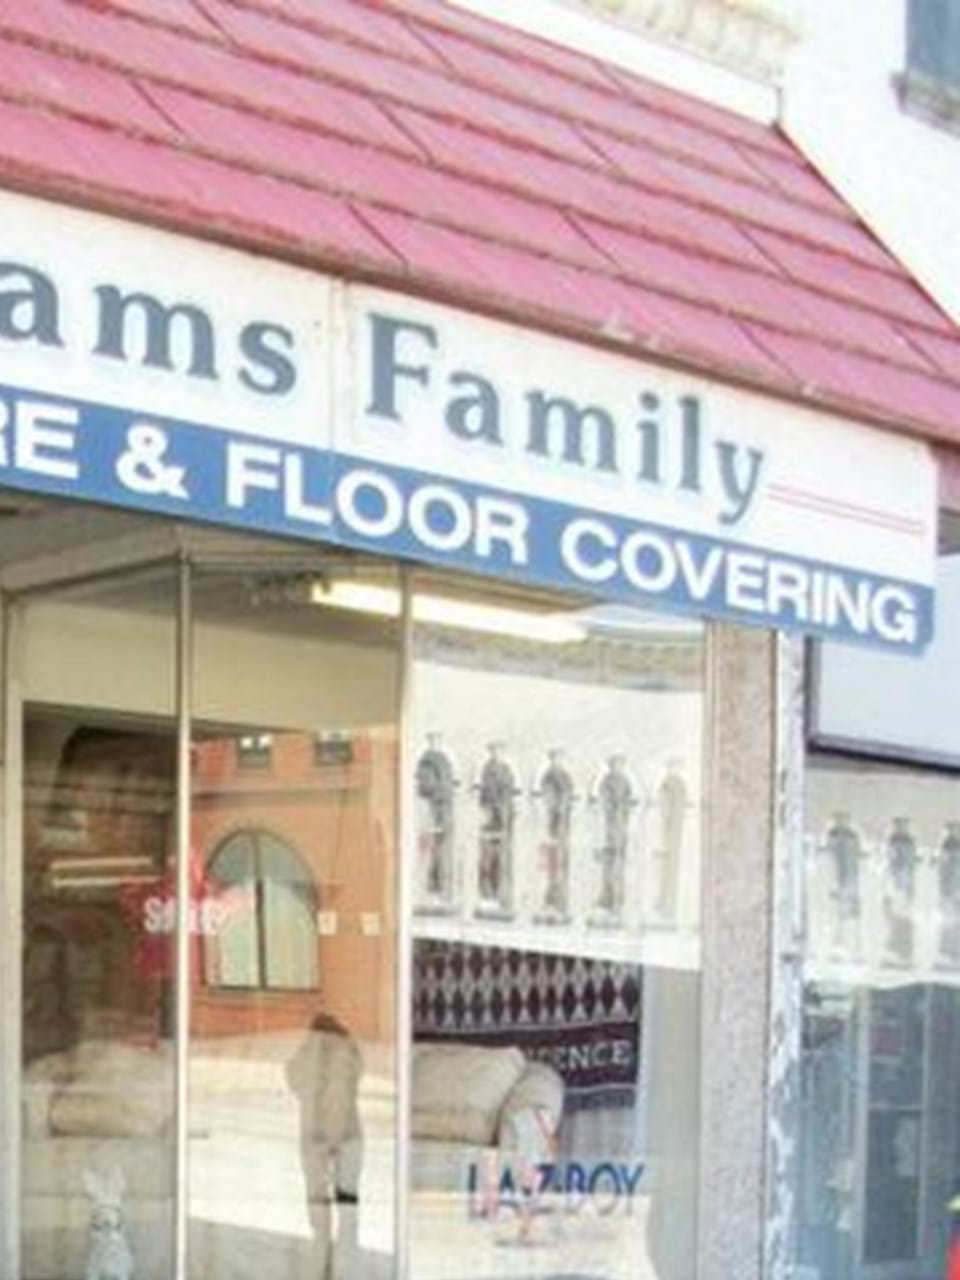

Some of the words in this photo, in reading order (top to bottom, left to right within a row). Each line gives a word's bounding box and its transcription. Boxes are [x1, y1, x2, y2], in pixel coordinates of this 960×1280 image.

[363, 310, 764, 524] Family
[113, 422, 190, 501] &
[224, 443, 529, 566] FLOOR
[560, 518, 916, 645] COVERING
